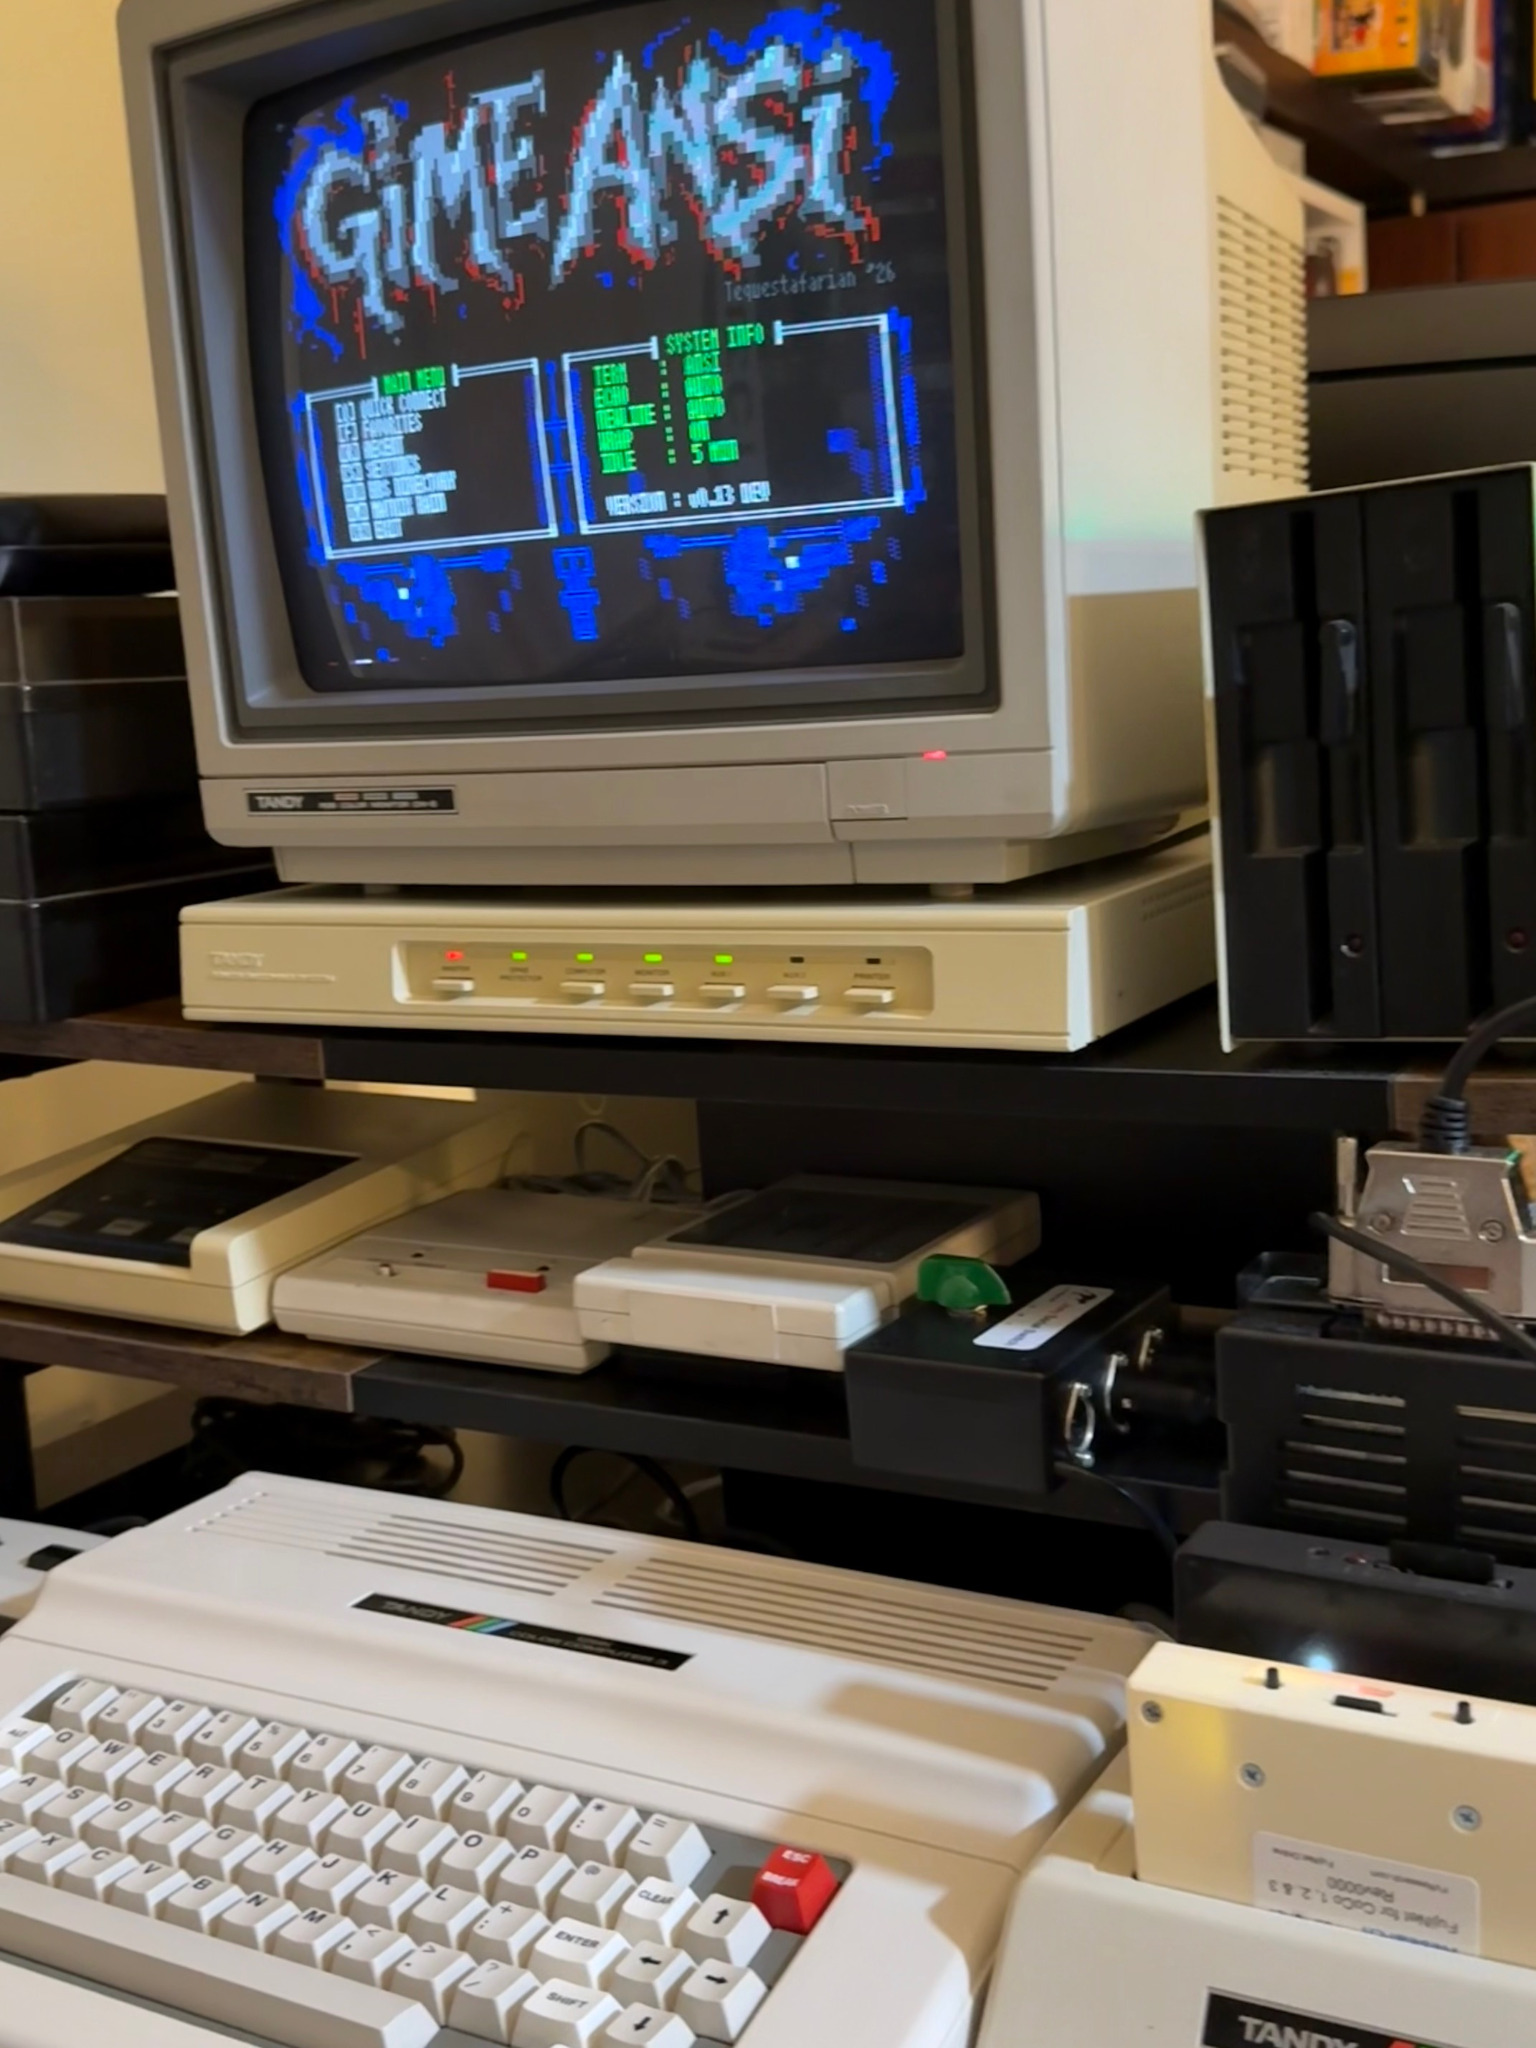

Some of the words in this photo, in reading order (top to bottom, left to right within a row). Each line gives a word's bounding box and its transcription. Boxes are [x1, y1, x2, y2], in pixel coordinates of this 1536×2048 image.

[665, 328, 720, 355] SYSTEM
[726, 322, 765, 348] INFO
[105, 1707, 119, 1717] 2
[152, 1718, 167, 1729] 3
[56, 1731, 75, 1743] Q
[201, 1730, 213, 1740] 4
[103, 1742, 125, 1755] W
[249, 1741, 263, 1751] 5
[148, 1753, 167, 1766] E
[299, 1753, 313, 1764] 6
[196, 1766, 214, 1779] R
[352, 1765, 366, 1775] 7
[19, 1776, 38, 1787] A
[249, 1778, 267, 1790] T
[405, 1778, 420, 1790] 8
[66, 1788, 85, 1800] S
[302, 1790, 318, 1803] Y
[460, 1791, 475, 1803] 9
[114, 1800, 133, 1812] D
[352, 1804, 373, 1817] U
[163, 1813, 183, 1824] F
[406, 1818, 419, 1830] I
[216, 1827, 236, 1840] G
[41, 1835, 61, 1846] X
[464, 1834, 483, 1848] O
[266, 1841, 288, 1855] H
[520, 1848, 540, 1860] P
[91, 1850, 111, 1861] C
[781, 1849, 812, 1864] ESC
[143, 1863, 161, 1874] V
[322, 1857, 341, 1869] J
[192, 1878, 212, 1890] B
[377, 1871, 398, 1885] K
[1268, 1879, 1278, 1892] 3
[246, 1893, 269, 1907] N
[435, 1887, 449, 1901] L
[1333, 1894, 1376, 1915] CoCo
[302, 1909, 328, 1923] M
[1380, 1906, 1400, 1921] for
[554, 1930, 600, 1949] ENTER
[546, 1991, 589, 2009] SHIFT
